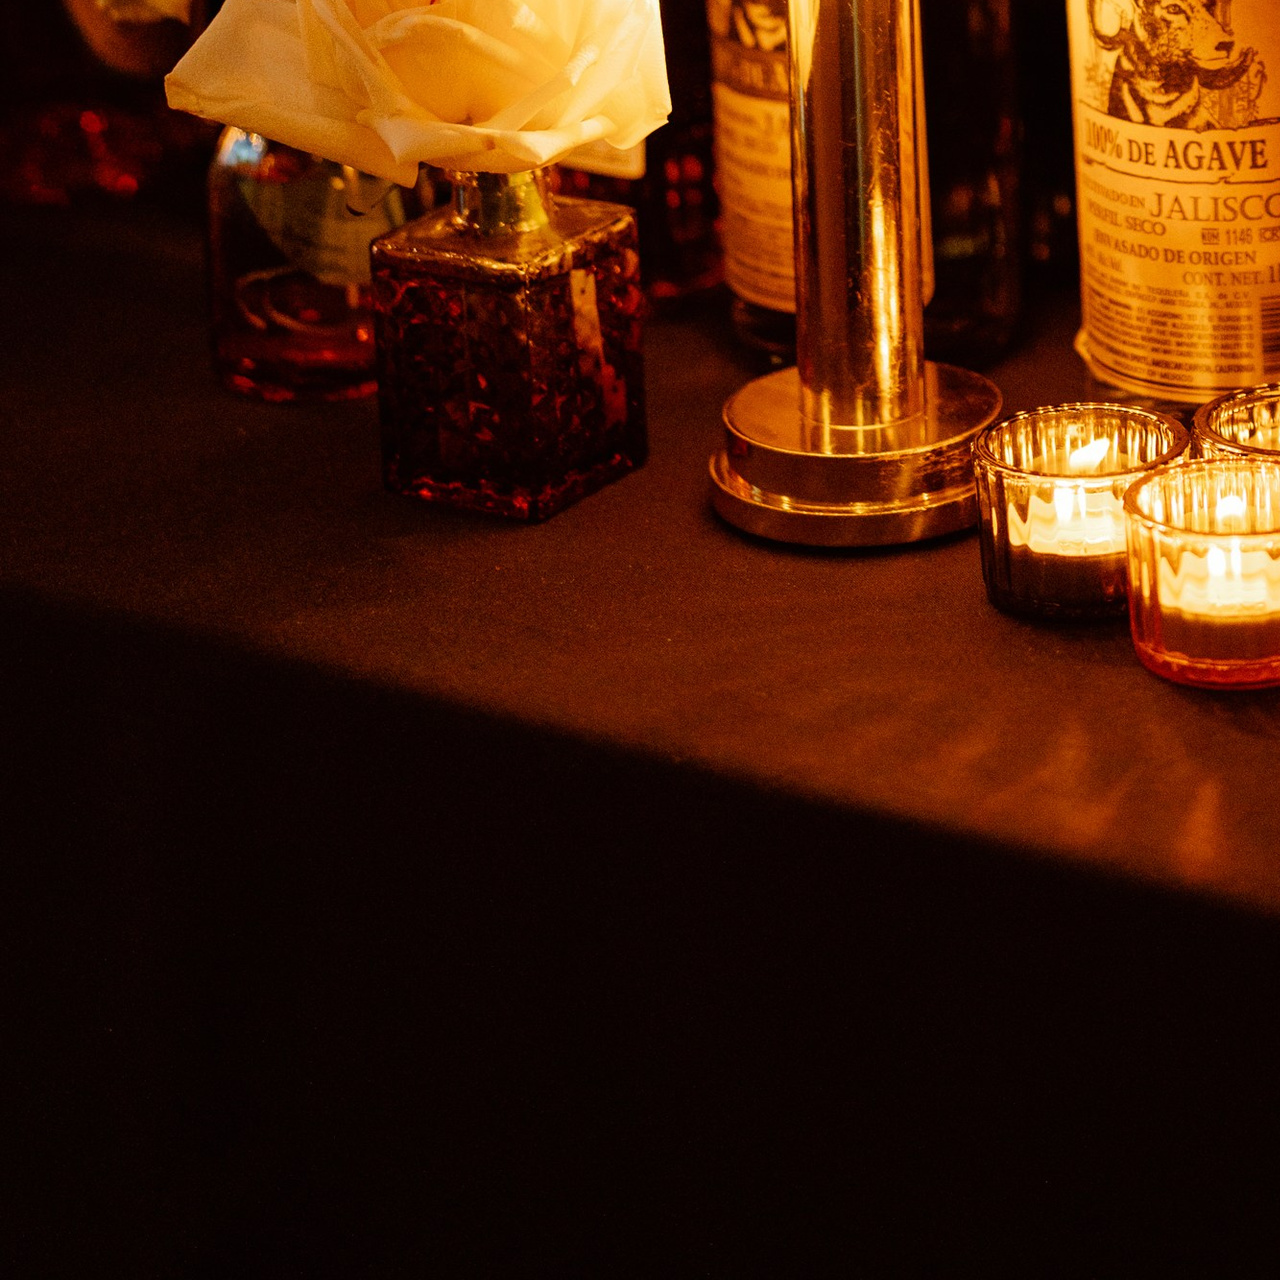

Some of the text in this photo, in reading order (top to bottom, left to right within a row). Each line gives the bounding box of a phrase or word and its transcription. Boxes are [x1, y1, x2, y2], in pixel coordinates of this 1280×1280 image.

[1085, 118, 1268, 171] 100% DE AGAVE
[1125, 215, 1167, 237] SECO
[1164, 248, 1185, 264] DE
[1189, 250, 1257, 266] ORIGEN
[1182, 271, 1228, 286] CONT.
[1231, 271, 1265, 286] NET.
